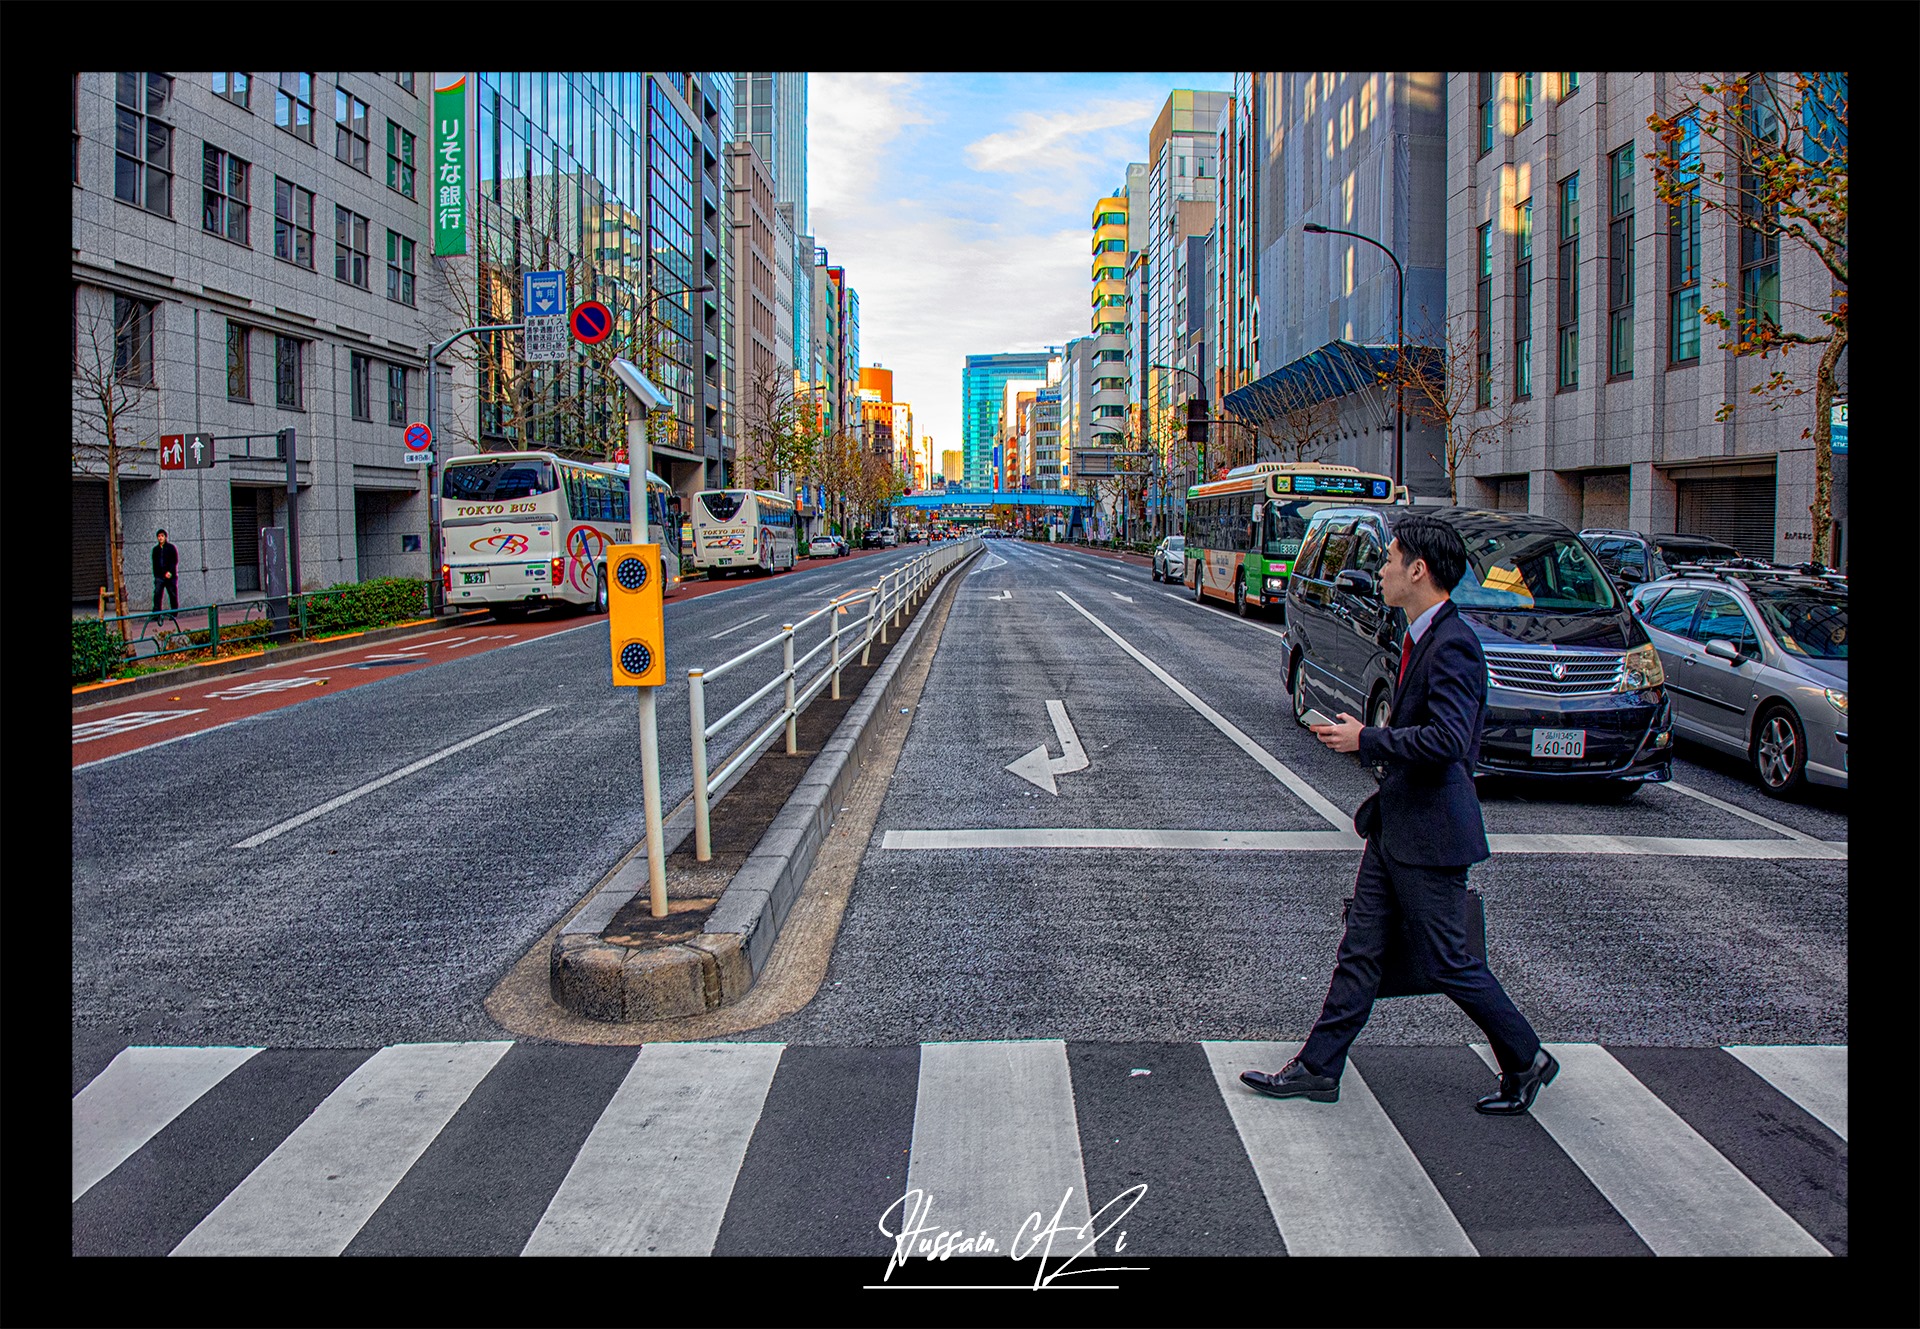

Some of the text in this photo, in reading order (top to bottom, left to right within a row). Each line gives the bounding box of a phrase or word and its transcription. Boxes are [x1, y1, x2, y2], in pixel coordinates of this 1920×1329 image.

[440, 119, 461, 229] りそな銀行
[535, 288, 555, 298] 専用
[528, 318, 563, 326] 路線バス
[457, 502, 537, 516] TOKYO BUS
[615, 528, 632, 541] TOKY
